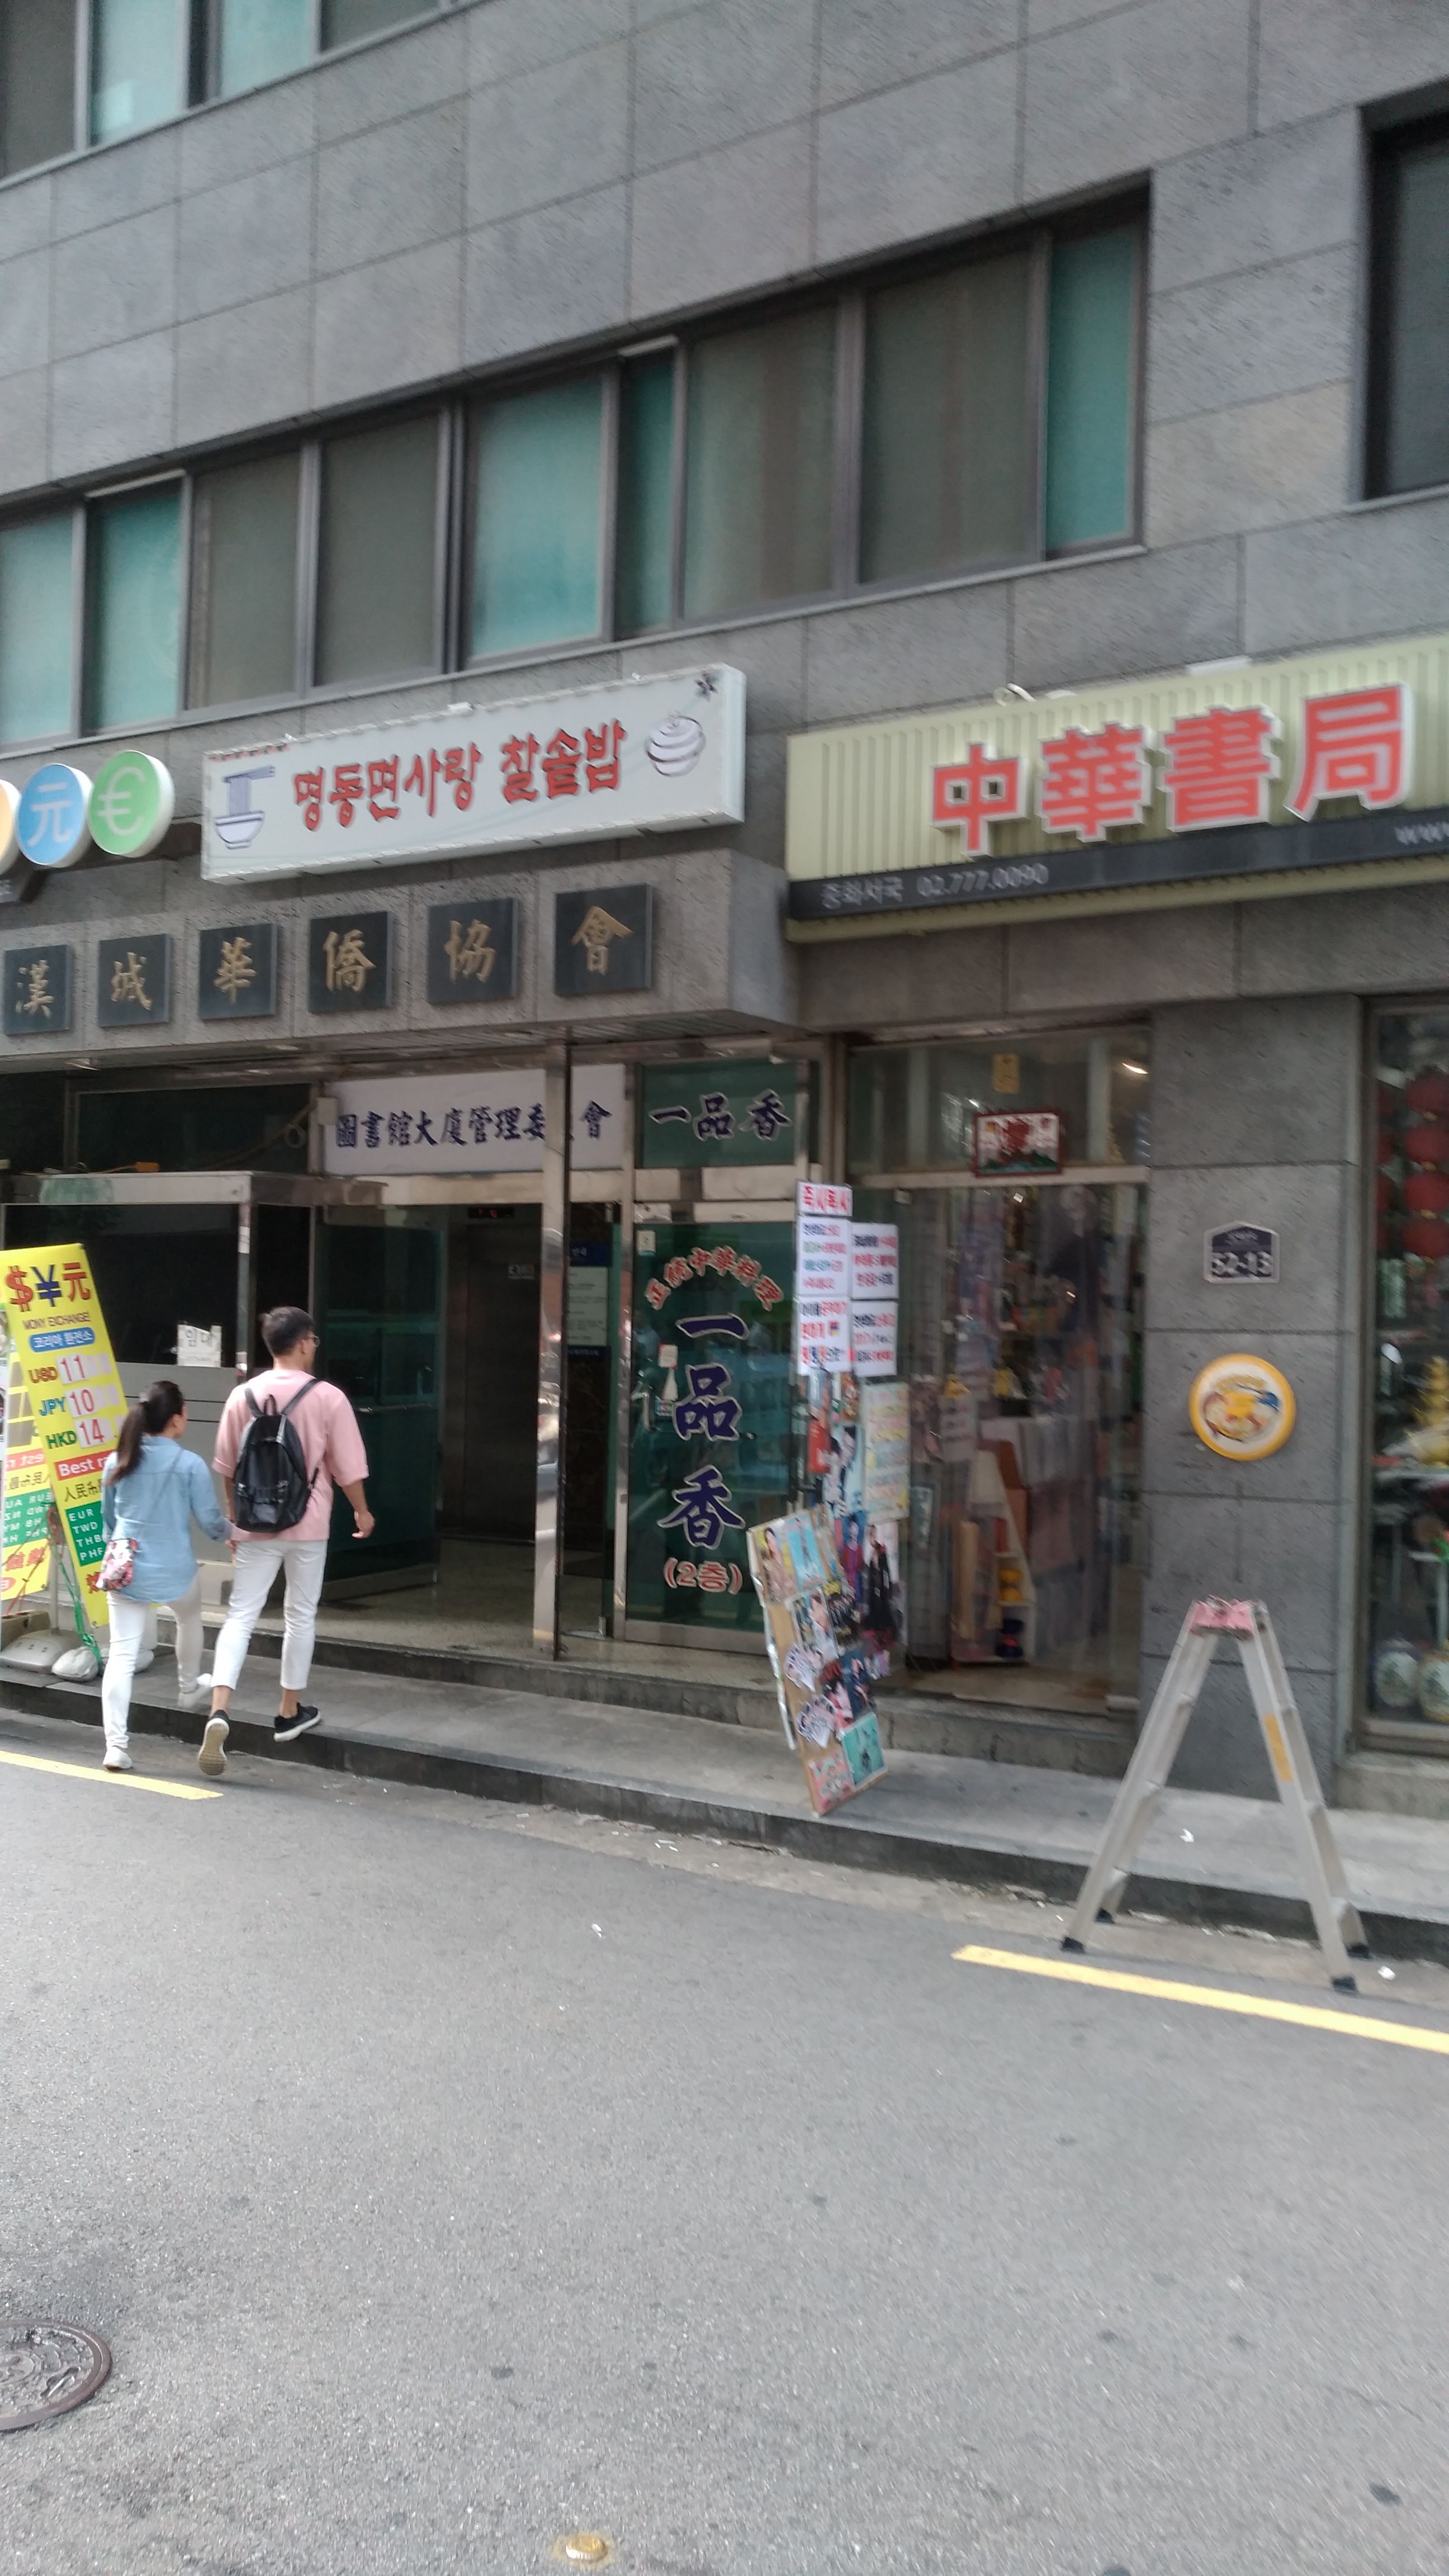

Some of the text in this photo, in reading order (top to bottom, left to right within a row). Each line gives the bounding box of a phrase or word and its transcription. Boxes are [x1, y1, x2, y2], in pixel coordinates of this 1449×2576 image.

[930, 683, 1409, 857] 中華書局
[294, 742, 483, 831] 명동면사랑
[27, 781, 73, 846] 元
[337, 1100, 613, 1148] 圖書館大廈管理委會
[648, 1089, 793, 1141] 一品香
[48, 1311, 91, 1327] EXCHANGE
[29, 1355, 85, 1383] USD 11
[39, 1389, 94, 1416] JPY 10
[45, 1419, 104, 1449] HKD 14
[657, 1313, 749, 1550] 一品香
[58, 1458, 95, 1476] Best
[68, 1508, 94, 1522] EUR
[72, 1522, 98, 1534] TWD
[76, 1534, 103, 1547] THB
